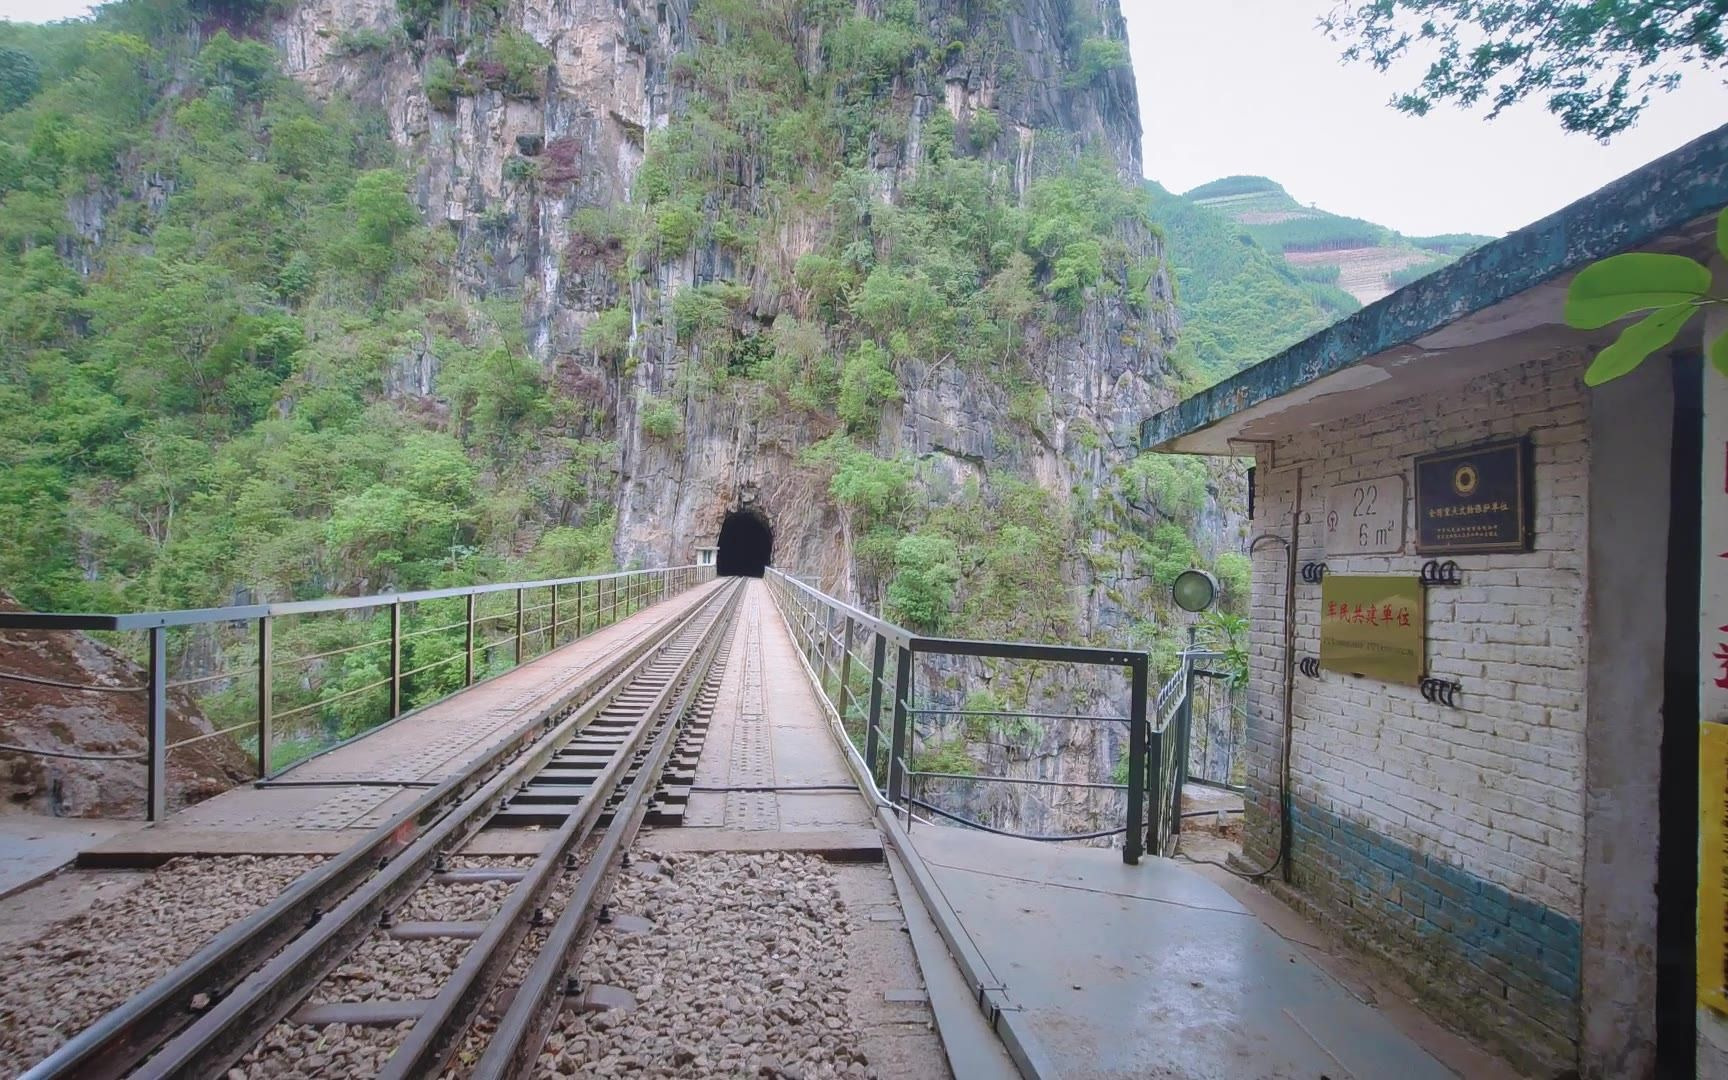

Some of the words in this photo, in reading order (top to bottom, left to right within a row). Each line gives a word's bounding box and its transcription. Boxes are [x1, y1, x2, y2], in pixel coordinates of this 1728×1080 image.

[1353, 485, 1377, 517] 22
[1359, 523, 1368, 546] 6
[1327, 601, 1411, 627] 军民共建单位
